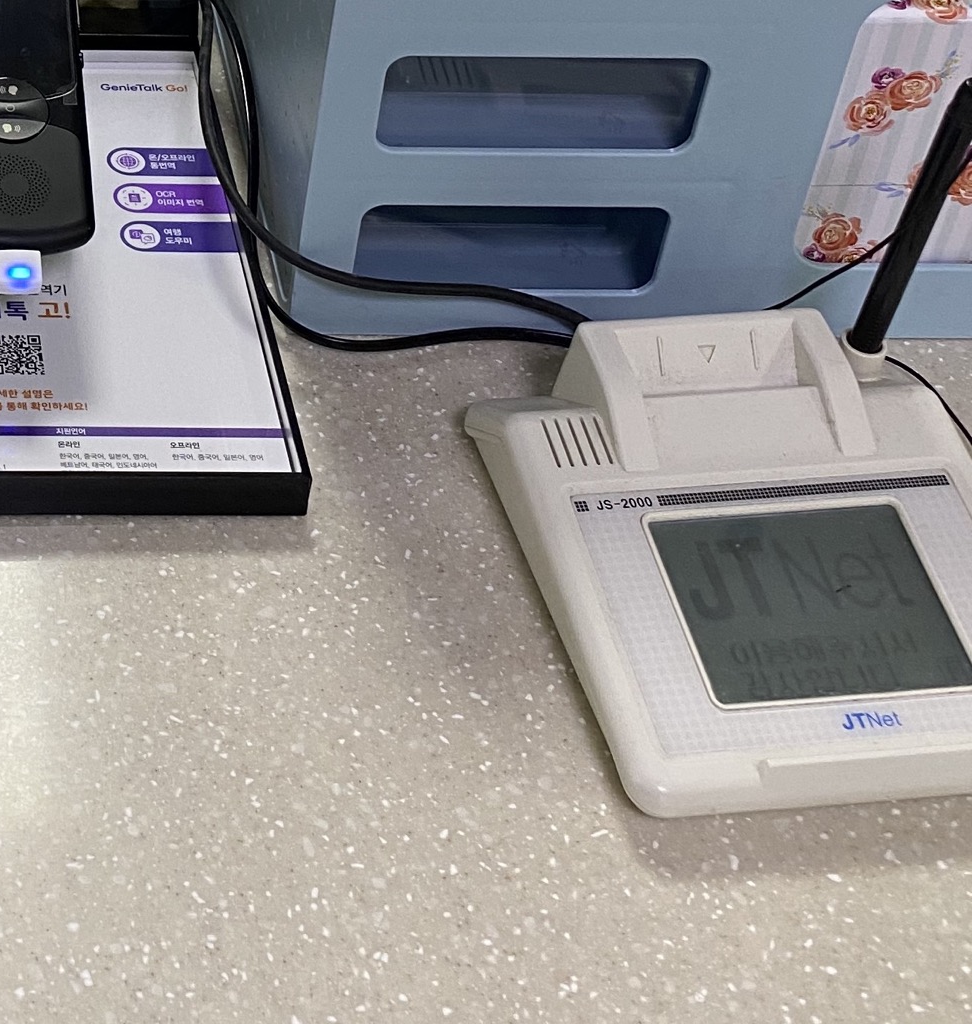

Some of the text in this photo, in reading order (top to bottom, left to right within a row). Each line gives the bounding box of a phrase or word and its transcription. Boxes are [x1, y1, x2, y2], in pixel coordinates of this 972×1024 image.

[100, 83, 188, 92] GenieTalk Go!
[155, 190, 176, 198] OCR
[157, 198, 205, 207] 이미지 번역
[165, 236, 193, 245] 도우미
[37, 301, 71, 320] 고!
[21, 389, 54, 399] 설명은
[6, 401, 28, 412] 통해
[30, 401, 89, 412] 확인하세요!
[57, 440, 81, 449] 온라인
[169, 441, 201, 450] 오프라인
[596, 496, 654, 511] JS-2000
[841, 710, 904, 731] JTNet
